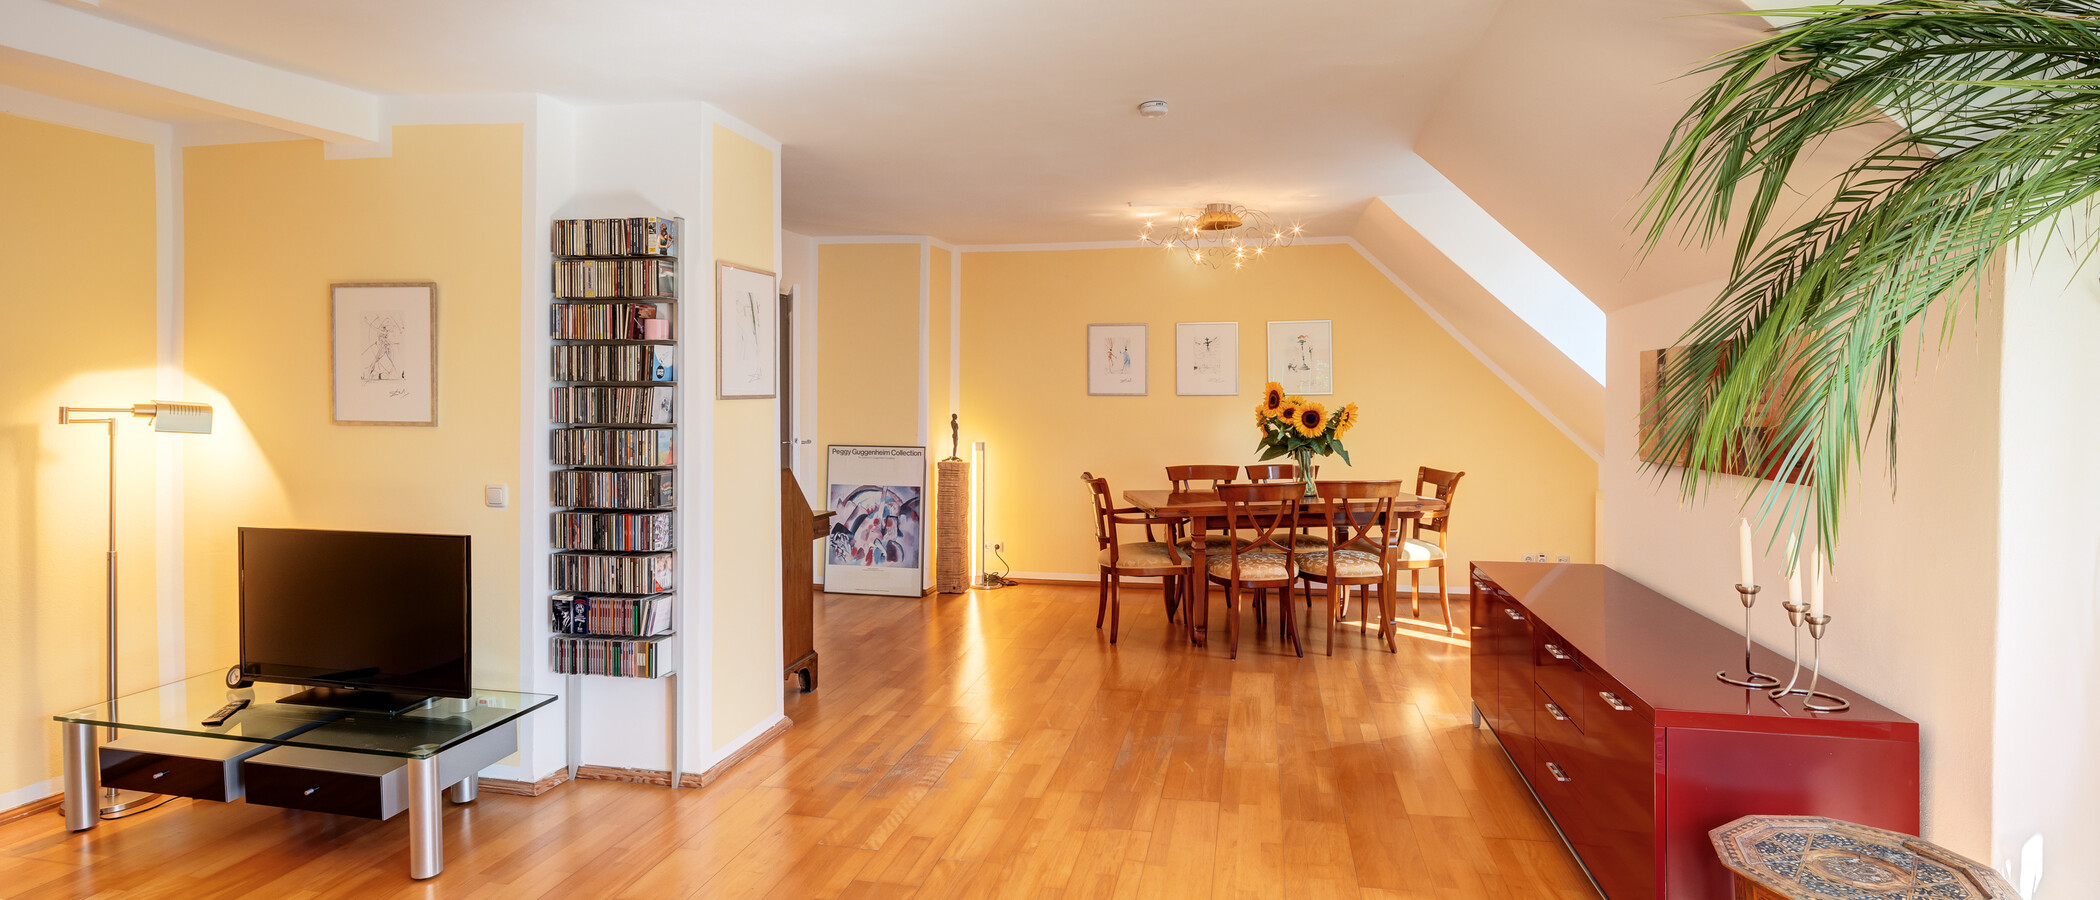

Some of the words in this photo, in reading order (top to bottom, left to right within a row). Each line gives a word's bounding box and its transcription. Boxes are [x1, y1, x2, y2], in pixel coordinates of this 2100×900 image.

[832, 448, 851, 456] Peggy
[852, 448, 890, 457] Guggenheim
[891, 449, 922, 457] Collection
